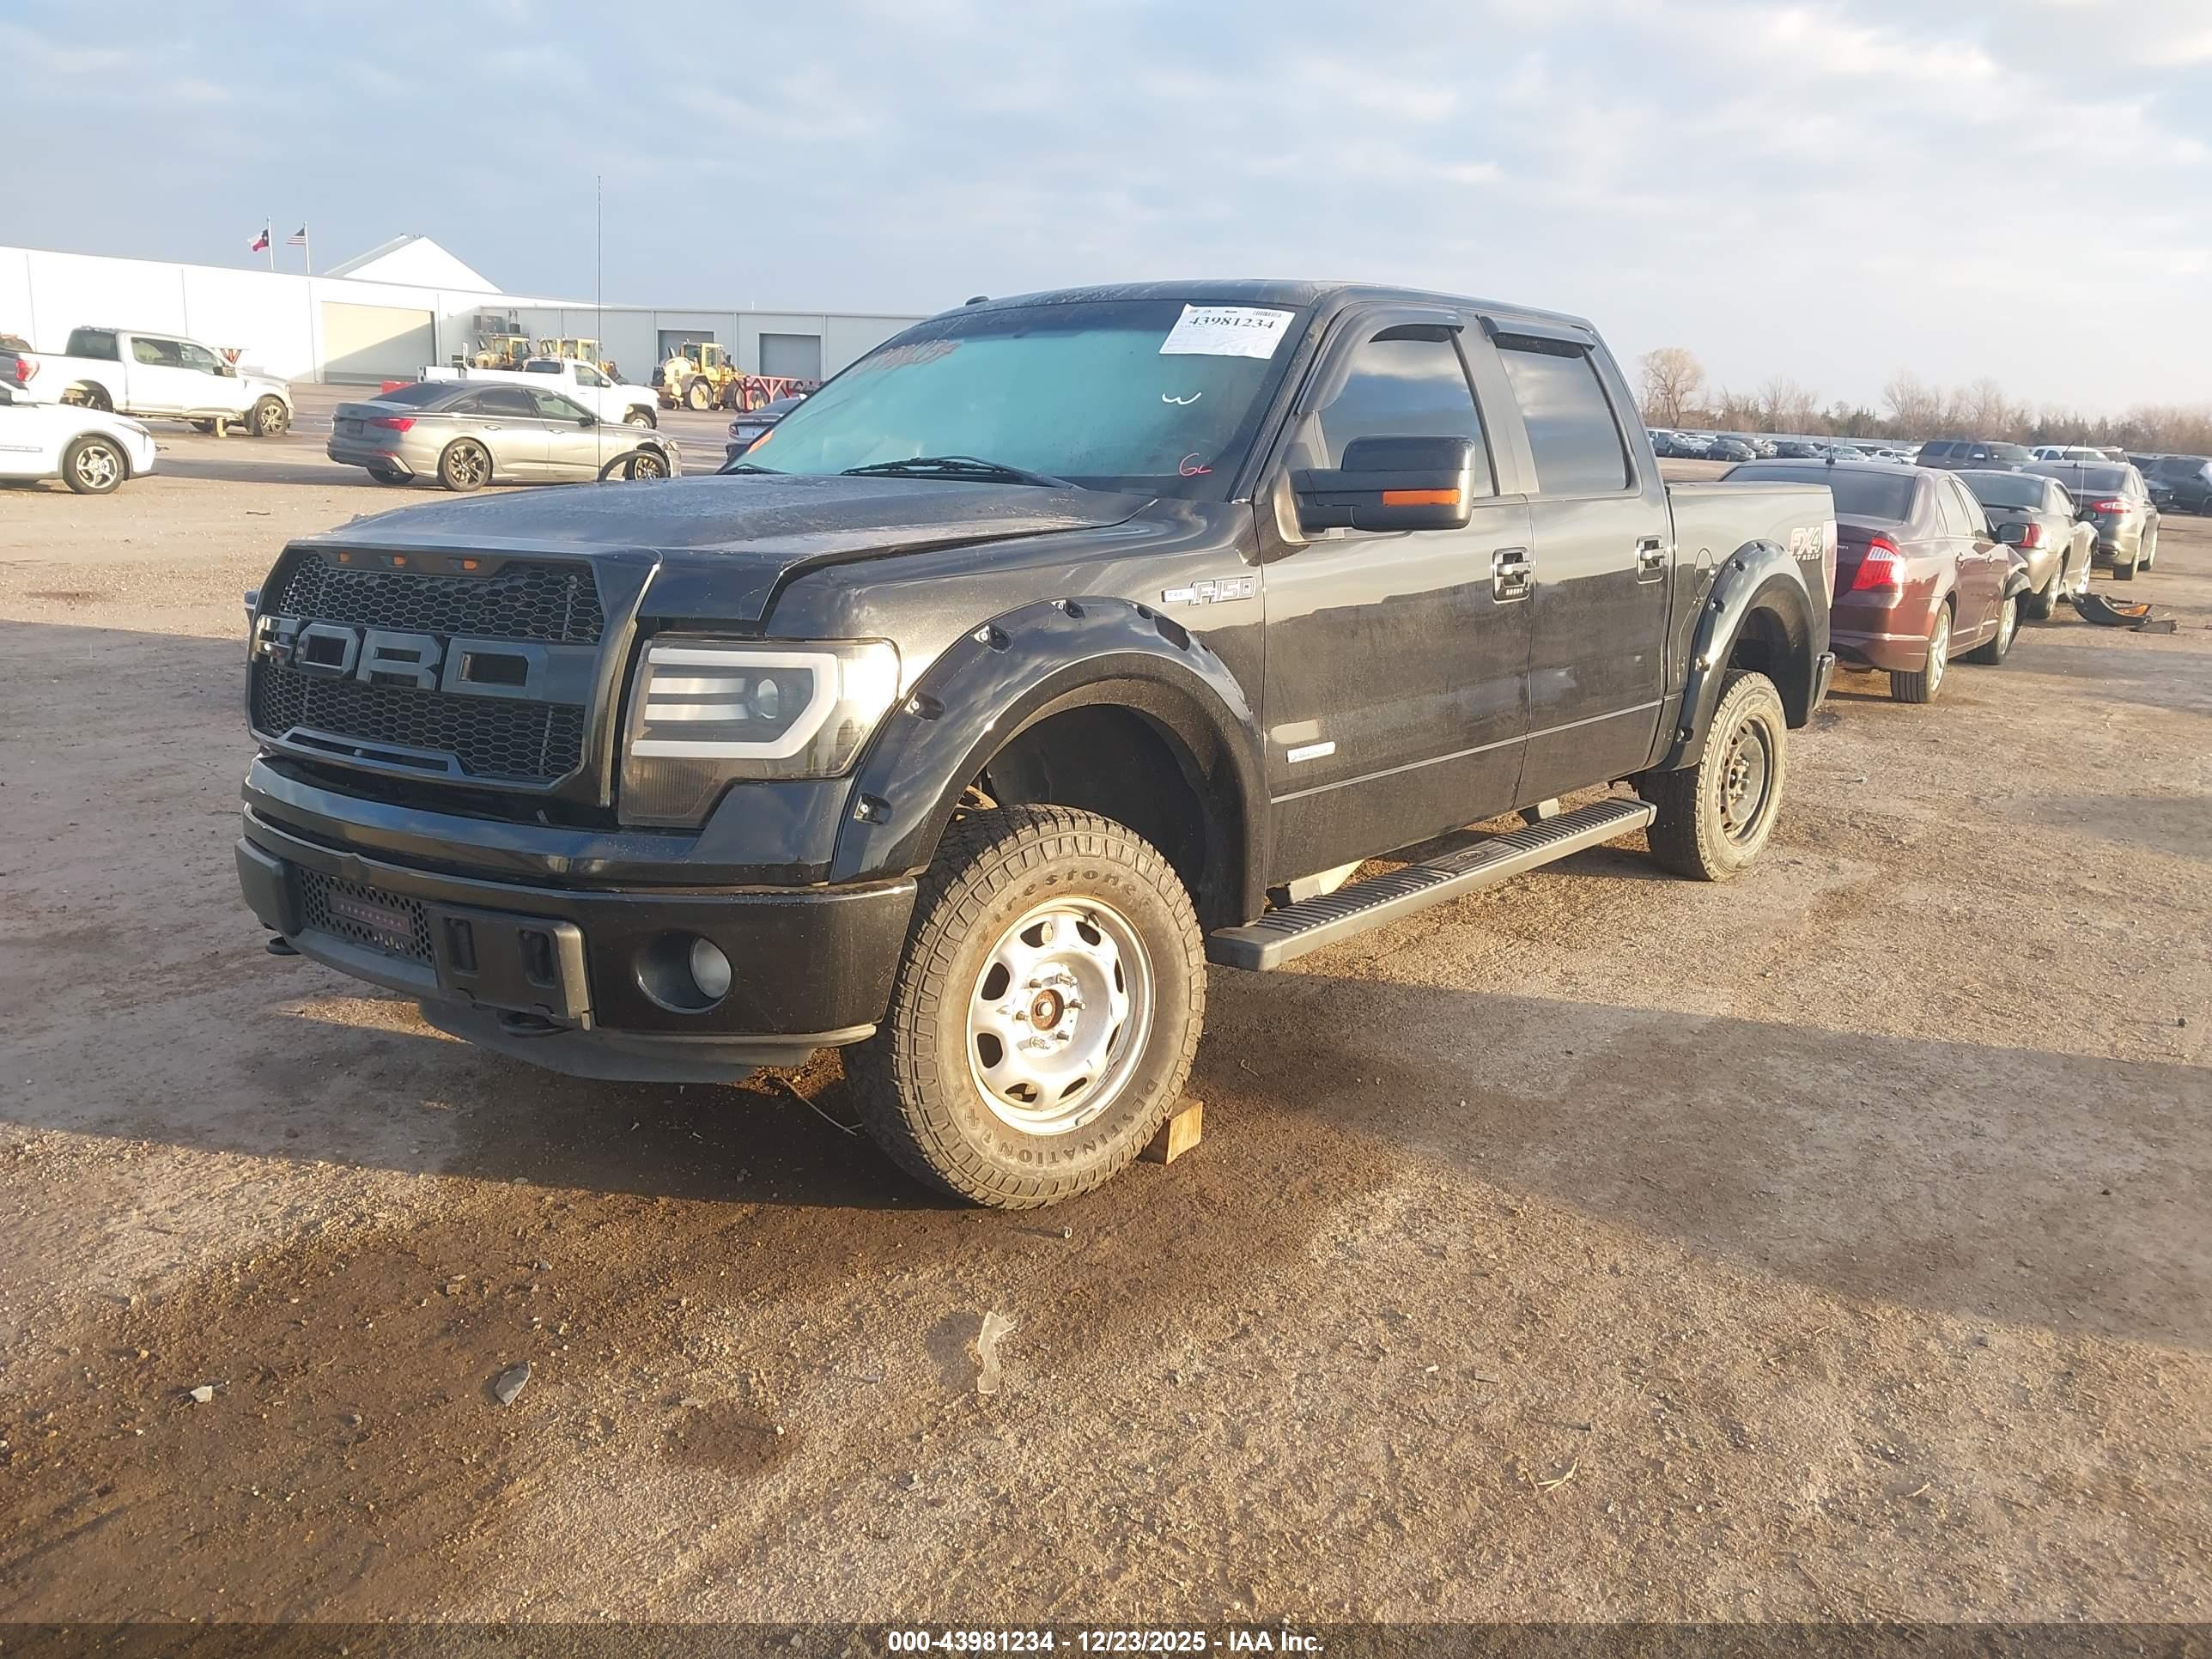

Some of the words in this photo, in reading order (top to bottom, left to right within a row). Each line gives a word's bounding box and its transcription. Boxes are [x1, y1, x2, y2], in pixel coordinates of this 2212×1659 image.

[1188, 314, 1276, 330] 43981234
[1790, 526, 1822, 556] FX4
[1188, 577, 1256, 606] F-150
[255, 614, 550, 701] FORD
[998, 1077, 1159, 1169] DESTINATION
